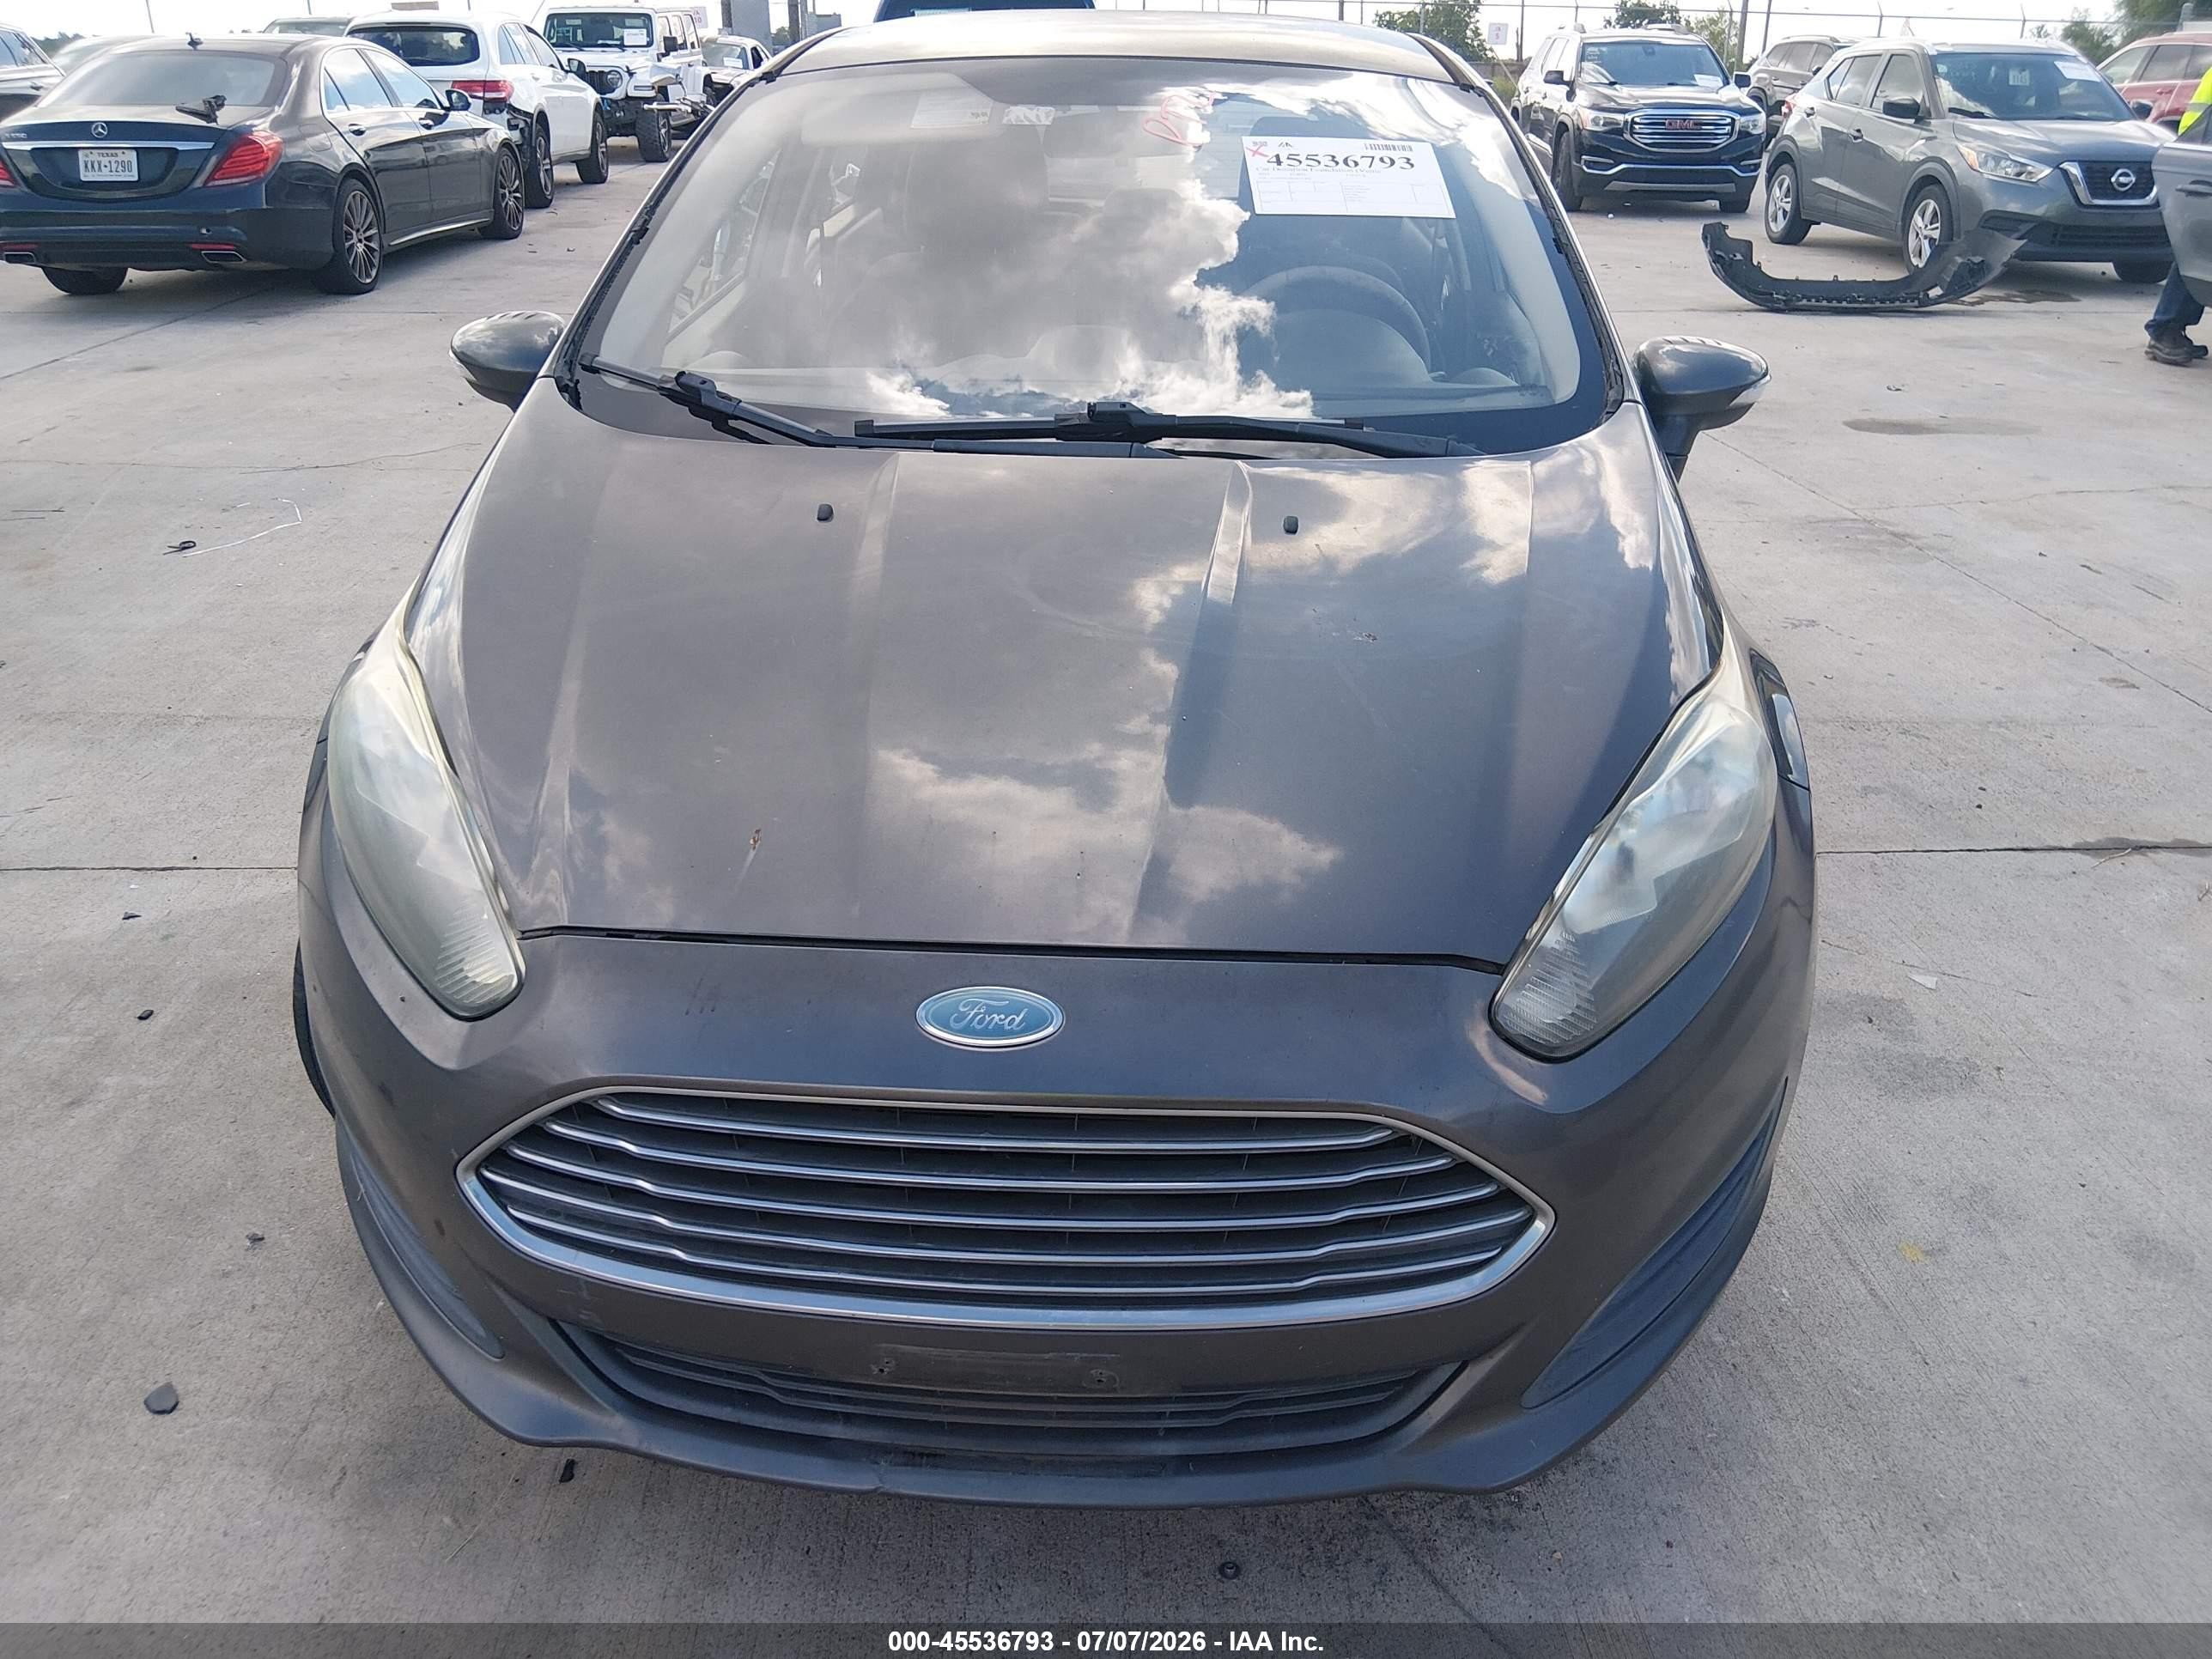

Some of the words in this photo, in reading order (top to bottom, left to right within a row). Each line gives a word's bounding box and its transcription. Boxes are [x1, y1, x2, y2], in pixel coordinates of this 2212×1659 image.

[1666, 118, 1702, 131] GMC
[1266, 153, 1416, 170] 45536793
[949, 998, 1029, 1031] Ford
